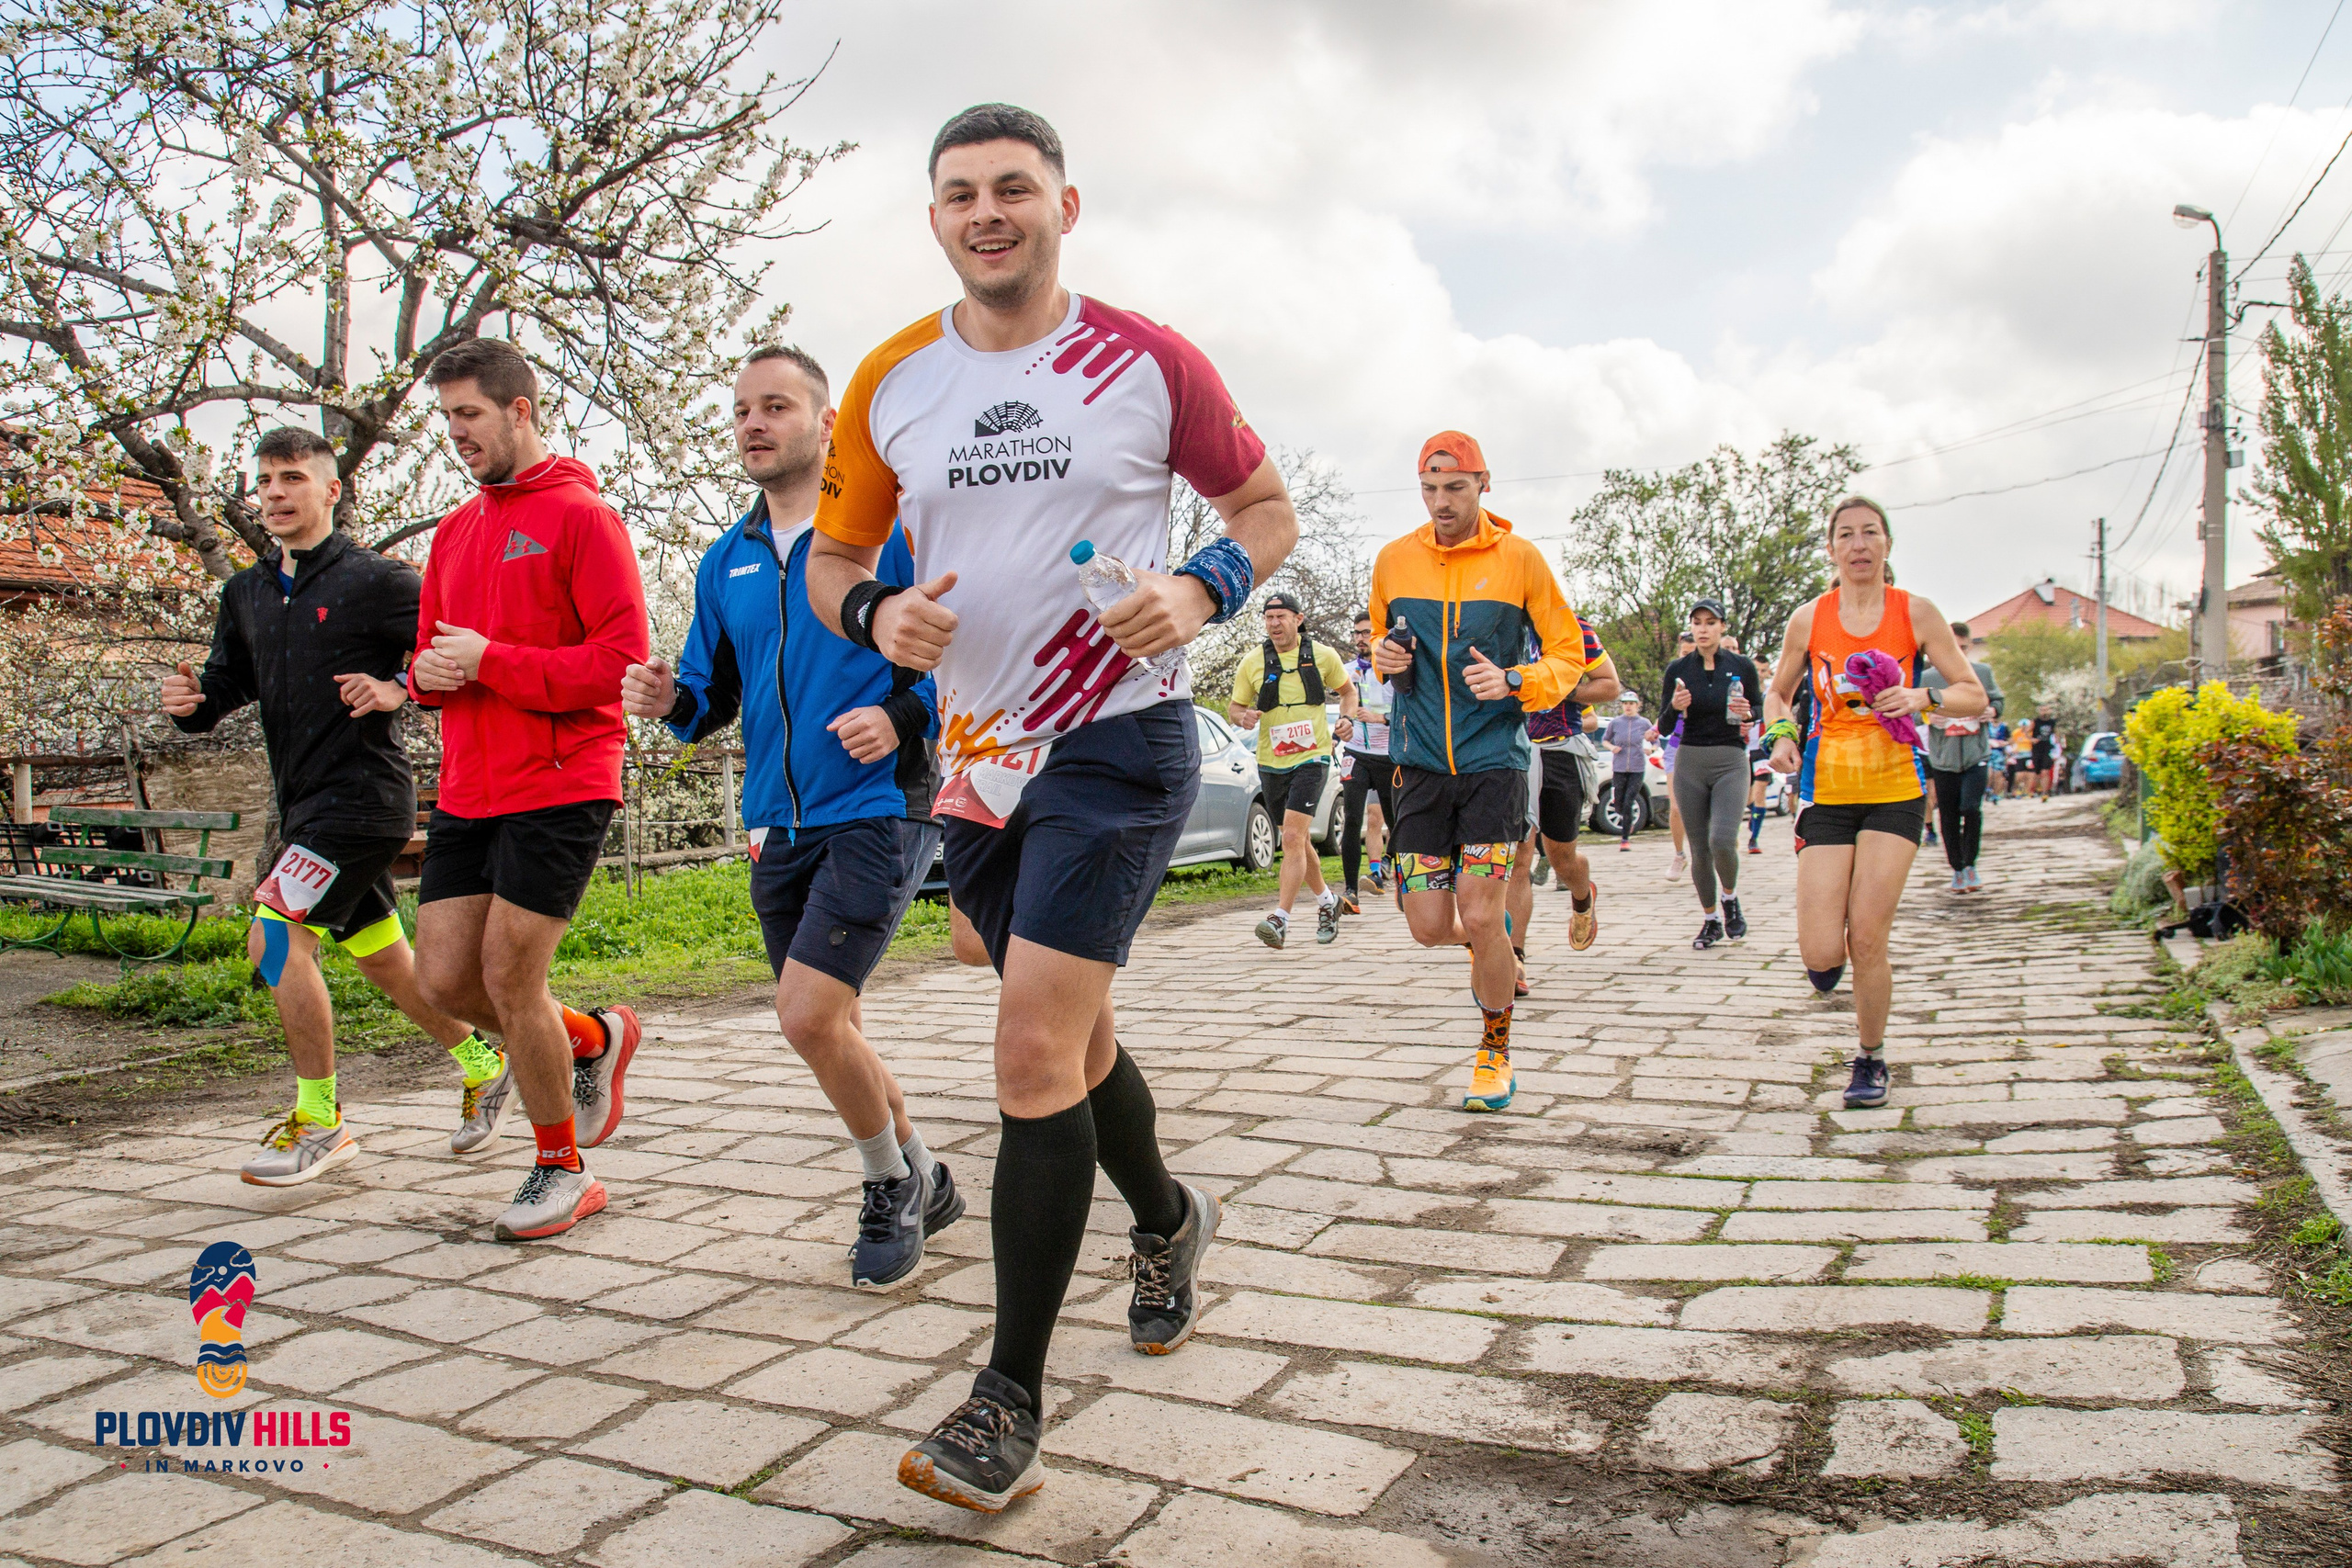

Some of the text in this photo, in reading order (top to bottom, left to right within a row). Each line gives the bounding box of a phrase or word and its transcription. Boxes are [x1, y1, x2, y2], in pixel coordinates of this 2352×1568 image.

[948, 435, 1072, 463] MARATHON
[948, 457, 1072, 489] PLOVDIV
[729, 562, 762, 579] TRIMTEX
[1287, 723, 1311, 739] 2176
[280, 852, 333, 890] 2177
